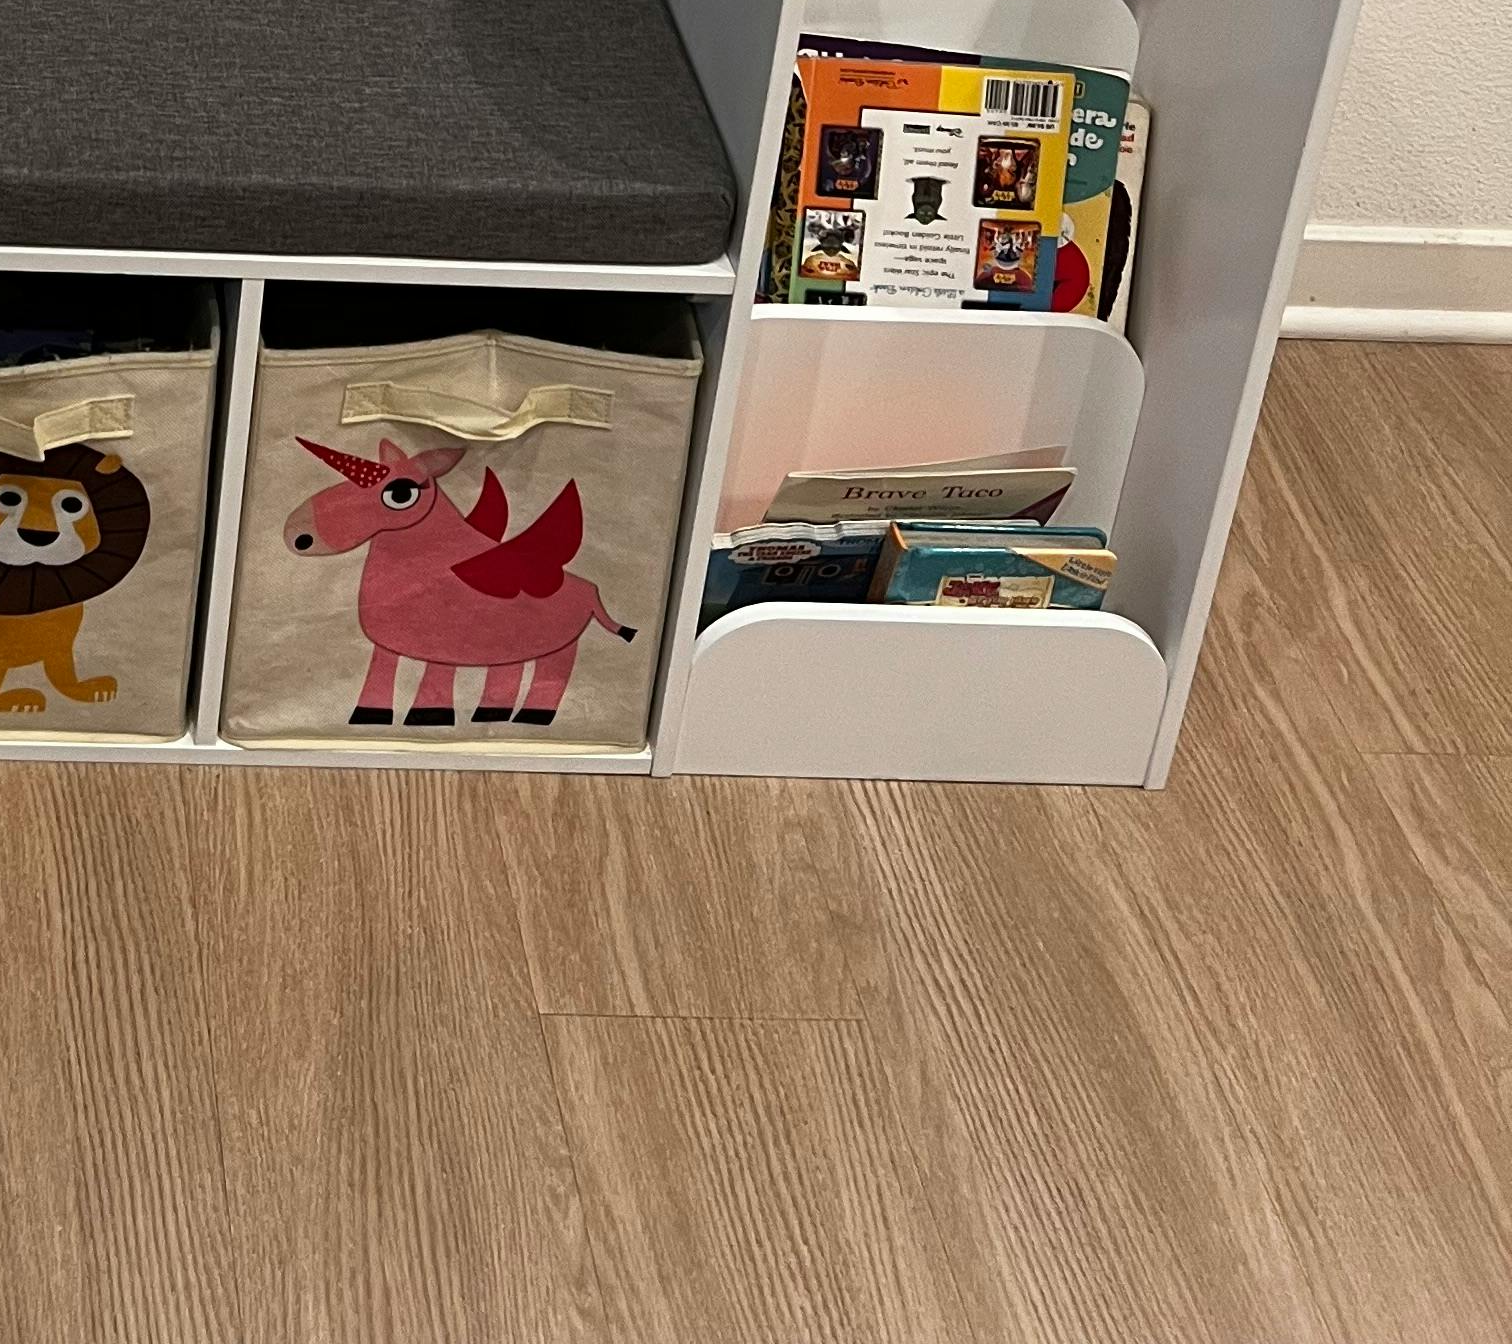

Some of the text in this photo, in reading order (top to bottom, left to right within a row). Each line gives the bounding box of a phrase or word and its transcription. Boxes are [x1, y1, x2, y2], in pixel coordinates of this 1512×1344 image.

[912, 232, 941, 240] Golden
[841, 485, 1004, 500] Brave Taco
